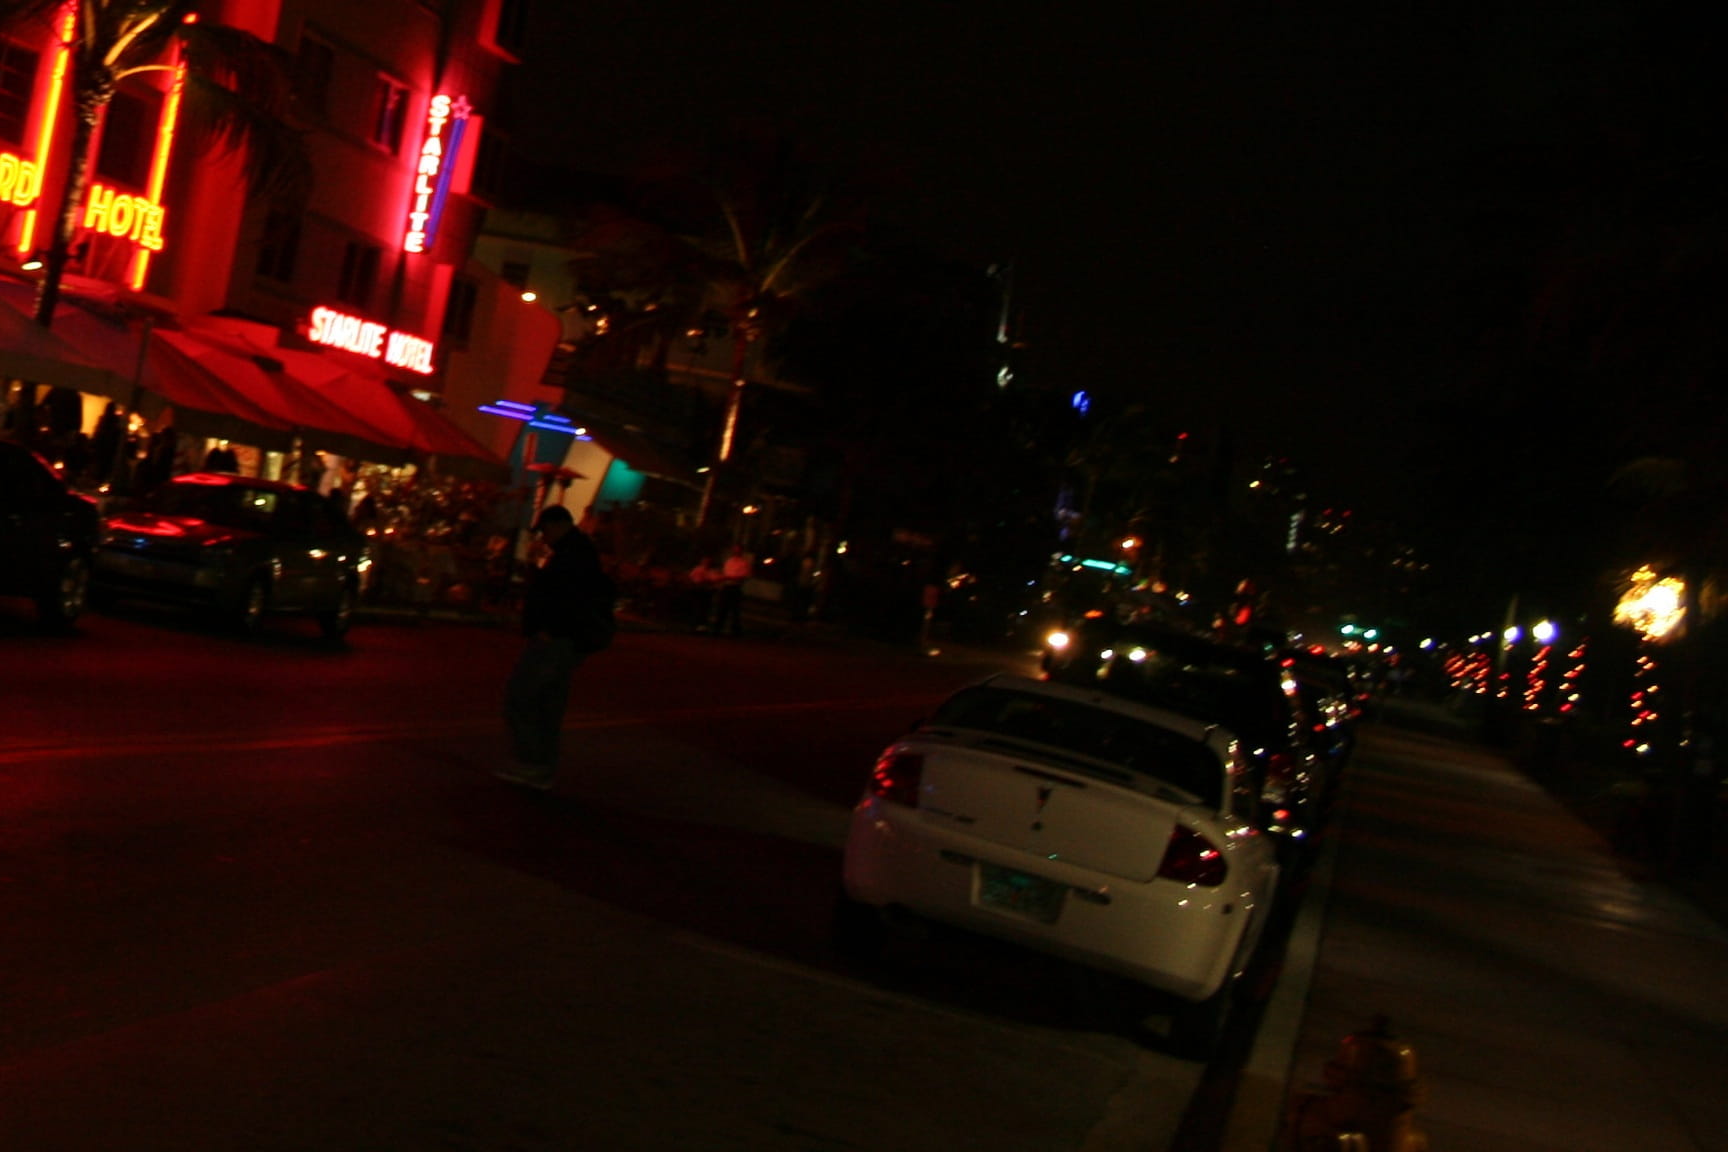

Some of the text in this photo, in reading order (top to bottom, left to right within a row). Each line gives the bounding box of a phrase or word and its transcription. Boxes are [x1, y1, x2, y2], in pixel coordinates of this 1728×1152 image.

[403, 95, 451, 252] STARLITE
[83, 183, 164, 251] HOTEL
[308, 306, 433, 374] STARLITE HOTEL
